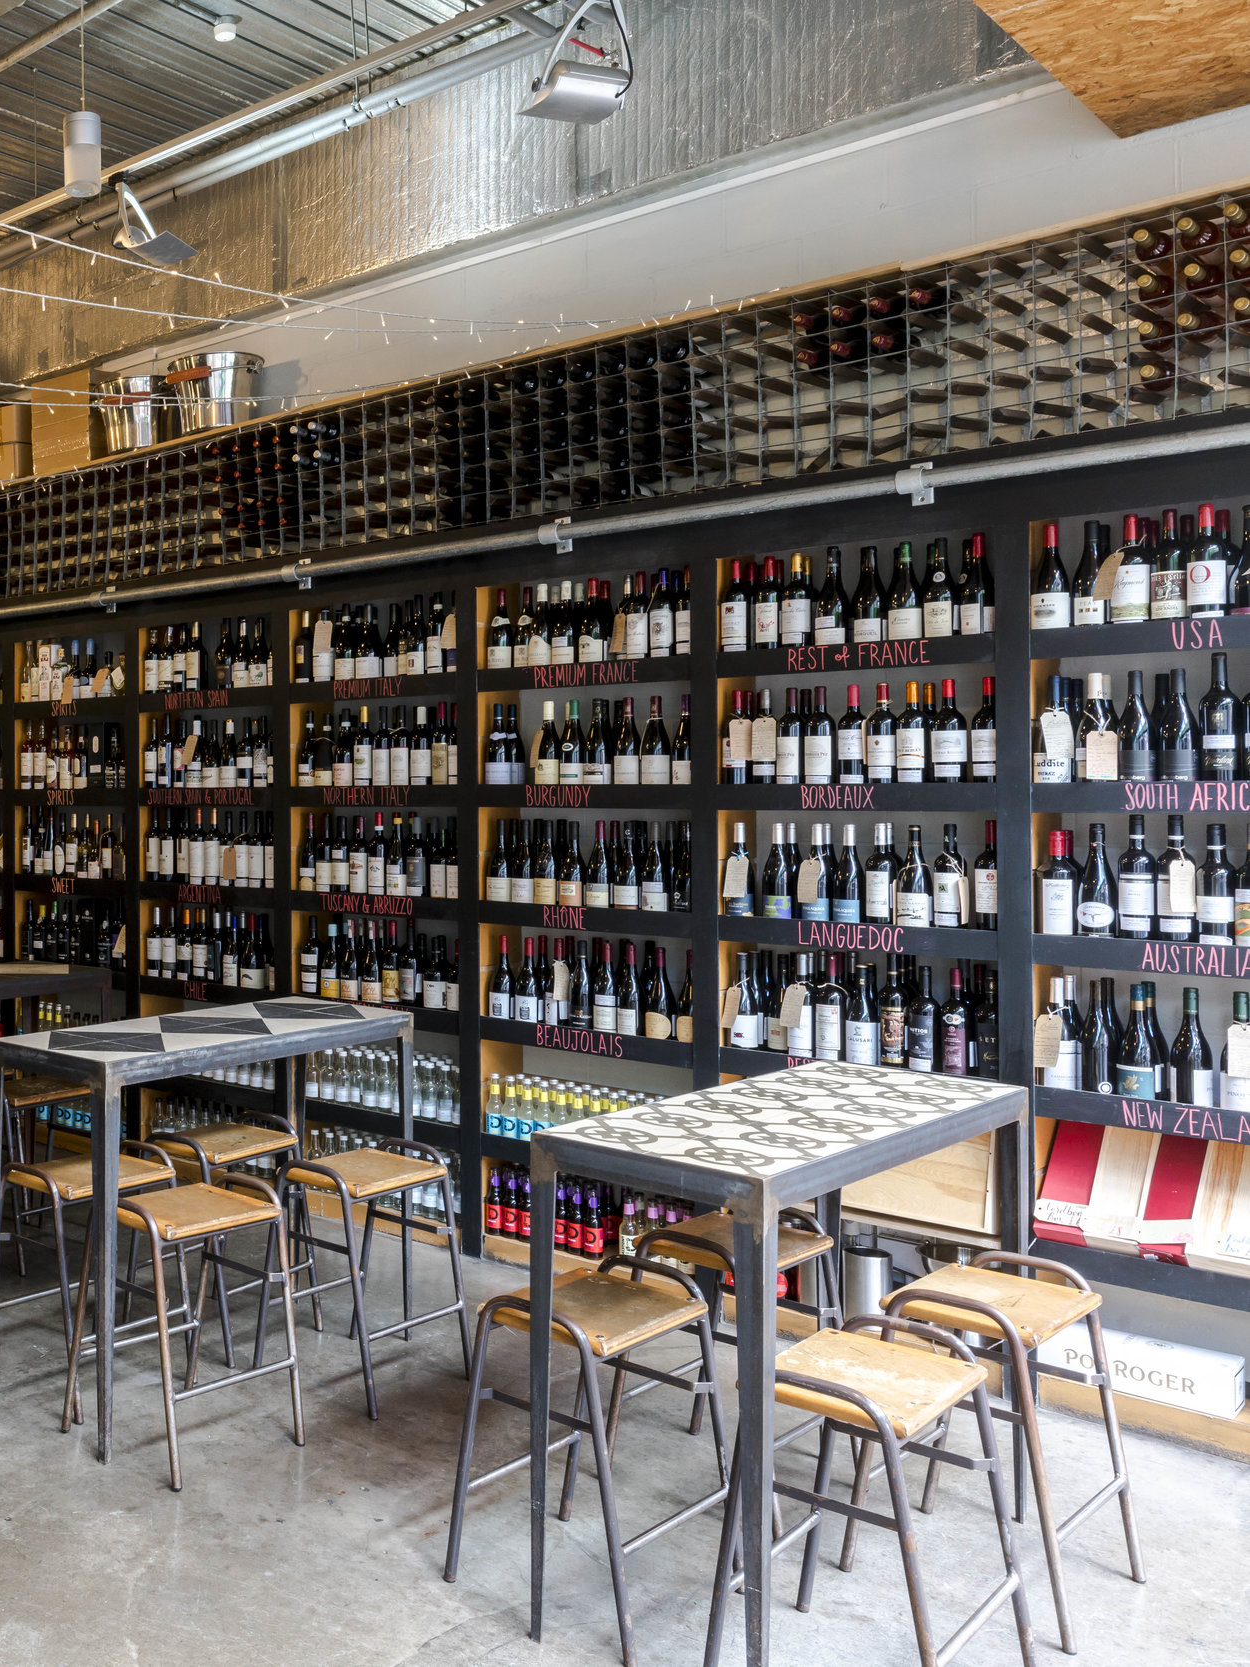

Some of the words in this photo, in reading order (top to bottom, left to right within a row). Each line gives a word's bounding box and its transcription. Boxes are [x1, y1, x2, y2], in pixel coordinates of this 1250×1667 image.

[1171, 619, 1224, 650] USA
[788, 645, 830, 672] REST
[834, 645, 851, 669] of
[858, 640, 931, 668] FRANCE
[533, 663, 587, 689] PREMIUM
[592, 660, 639, 685] FRANCE
[164, 691, 204, 711] NORTHERN
[207, 689, 229, 708] SPAIN
[333, 678, 371, 700] PREMIUM
[375, 677, 404, 698] ITALY
[51, 701, 77, 717] SPIRITS
[1036, 759, 1065, 768] uddite
[47, 789, 74, 806] SPIRITS
[147, 788, 183, 806] SOUTHERN
[184, 788, 201, 806] SPAIN
[204, 788, 212, 806] &
[213, 788, 254, 806] PORTUGAL
[323, 785, 375, 806] NORTHERN
[380, 785, 411, 807] ITALY
[525, 784, 591, 808] BURGUNDY
[800, 785, 875, 809] BORDEAUX
[1125, 782, 1179, 811] SOUTH
[51, 877, 75, 895] SWEET
[178, 884, 222, 904] ARGENTINA
[319, 893, 360, 914] TUSCANY
[362, 895, 371, 915] &
[373, 896, 414, 916] ABRUZZO
[543, 904, 588, 931] RHÔNE
[798, 921, 905, 953] LANGUEDOC
[183, 981, 208, 1001] CHILE
[536, 1024, 623, 1059] BEAUJOLAIS
[1121, 1099, 1164, 1131] NEW
[1064, 1348, 1095, 1370] PO
[1112, 1360, 1196, 1395] ROGER
